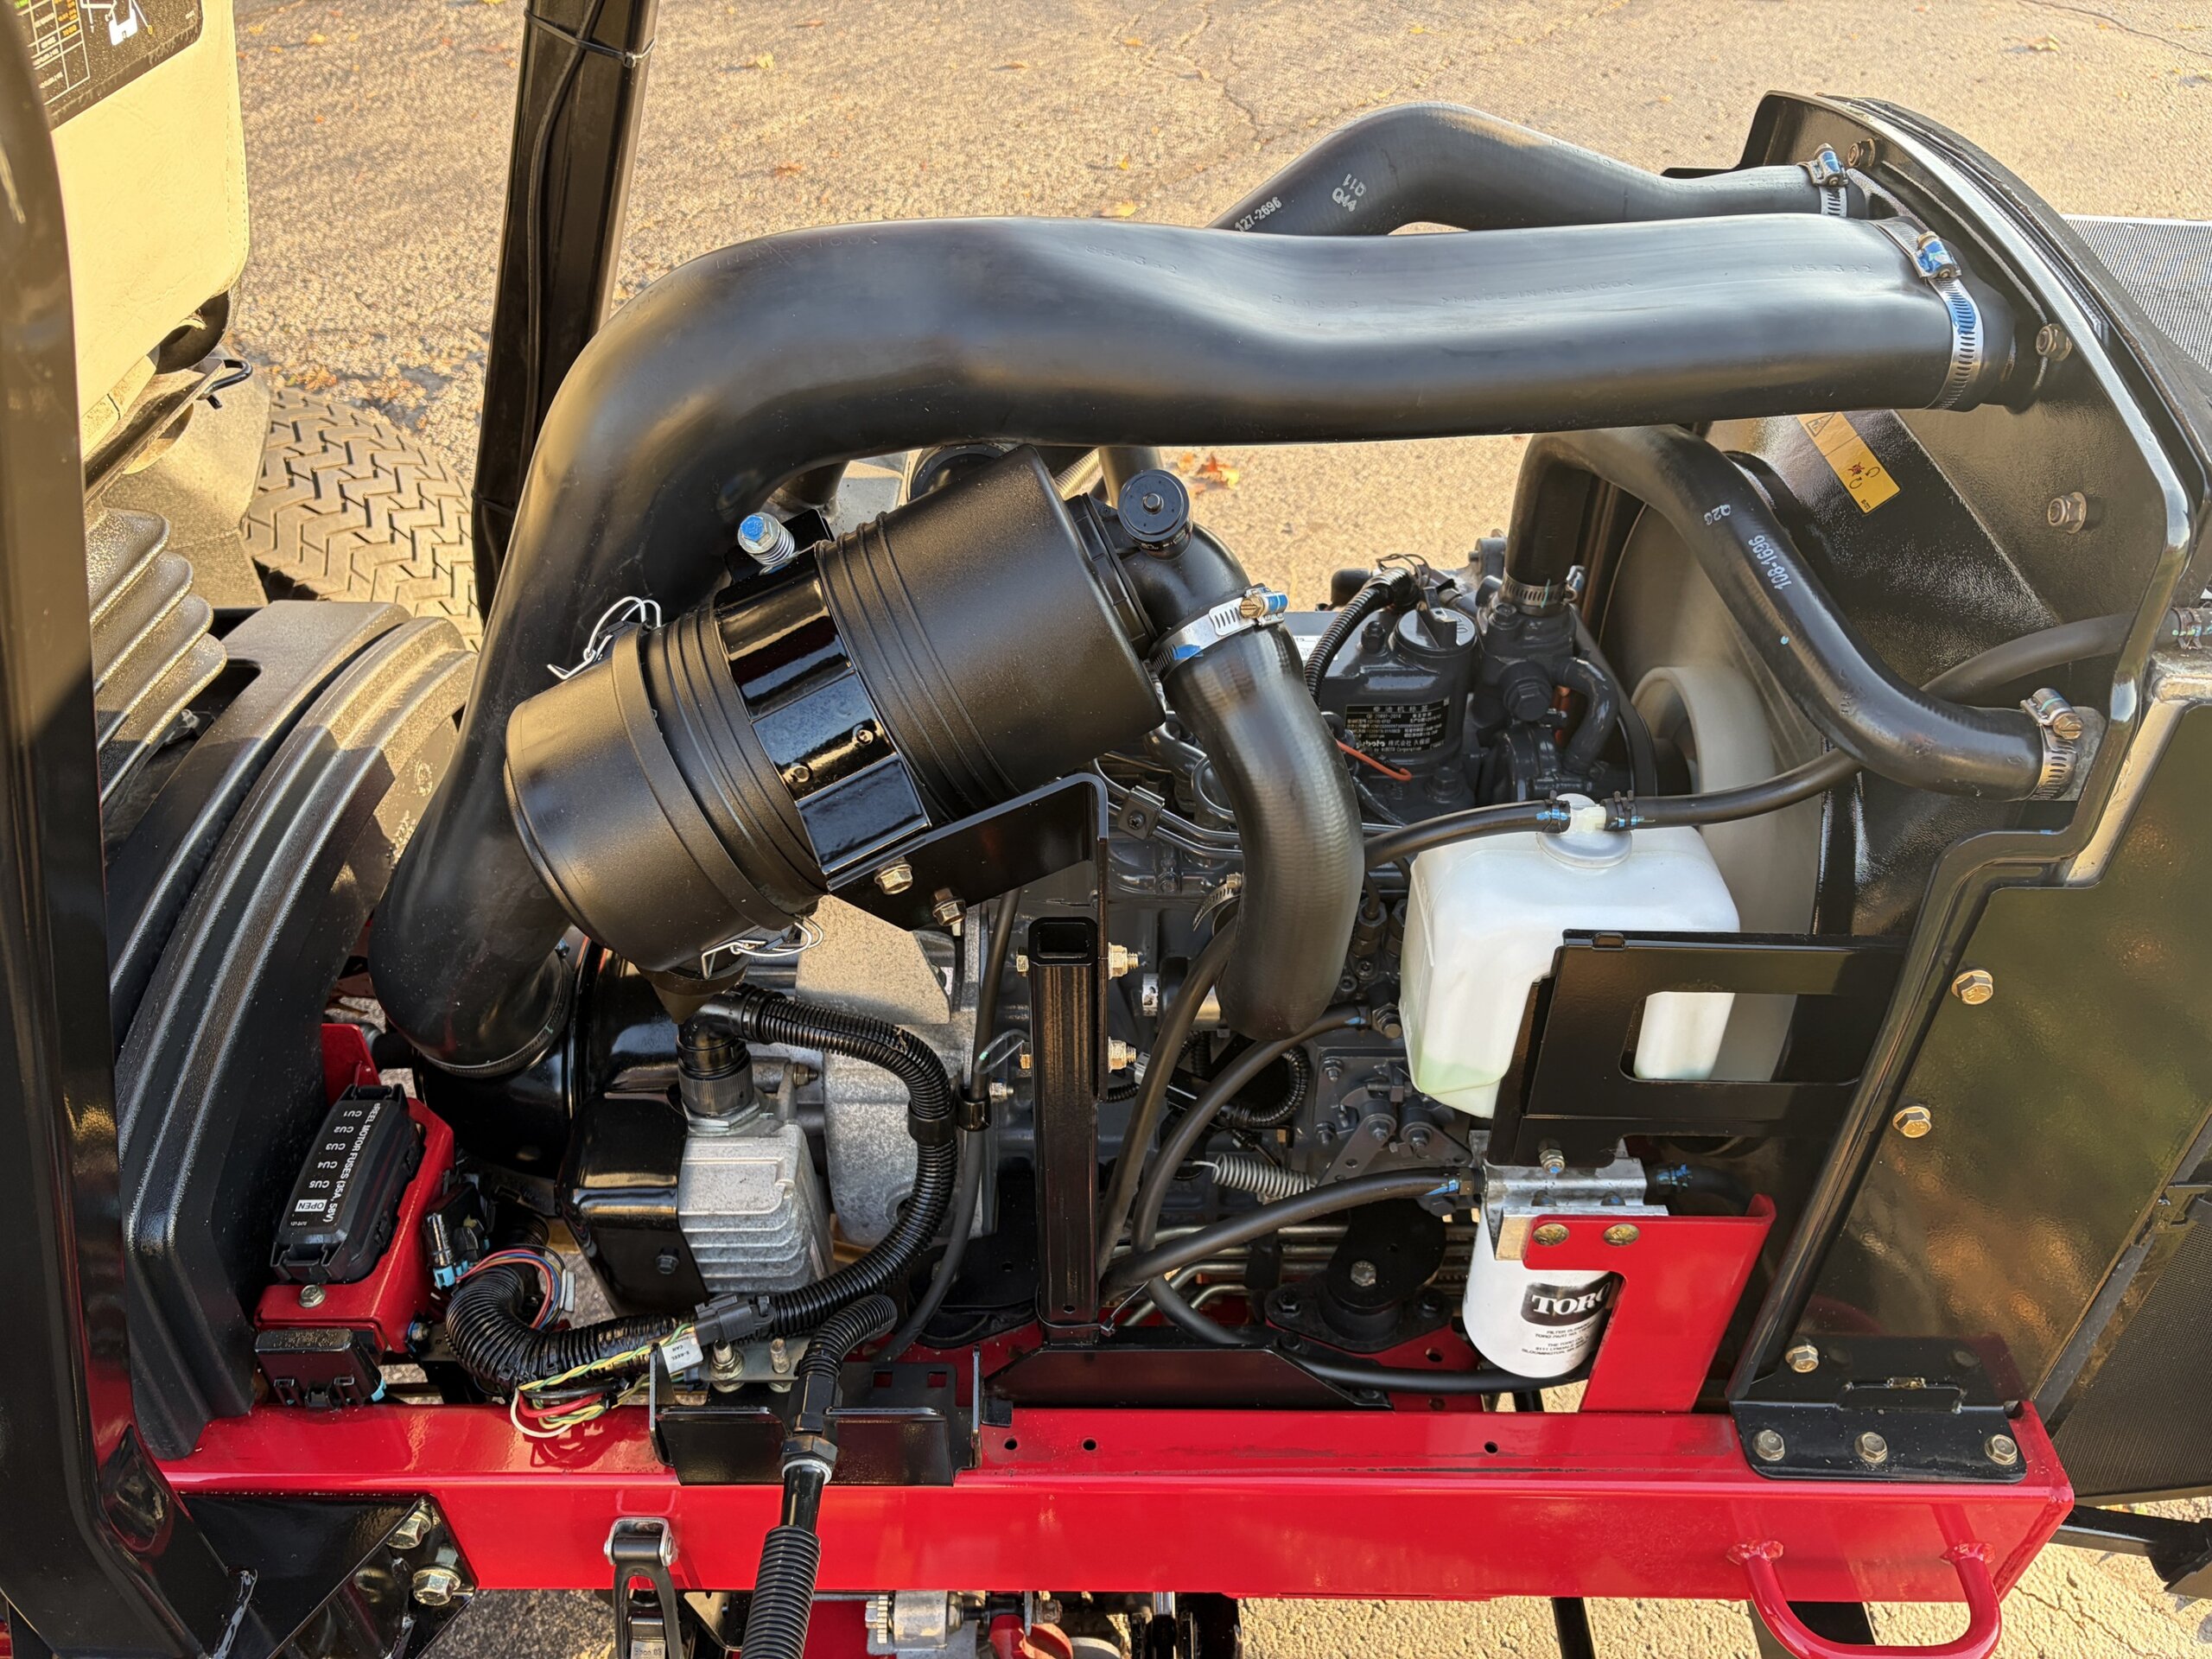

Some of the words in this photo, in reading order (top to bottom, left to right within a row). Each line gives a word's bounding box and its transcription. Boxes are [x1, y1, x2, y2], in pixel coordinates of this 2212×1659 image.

[1235, 197, 1282, 232] 127-2696
[1748, 535, 1792, 589] 108-1696
[352, 1125, 371, 1152] MOTOR
[340, 1152, 359, 1179] FUSES
[330, 1180, 346, 1201] (35A,
[322, 1203, 338, 1223] 58V)
